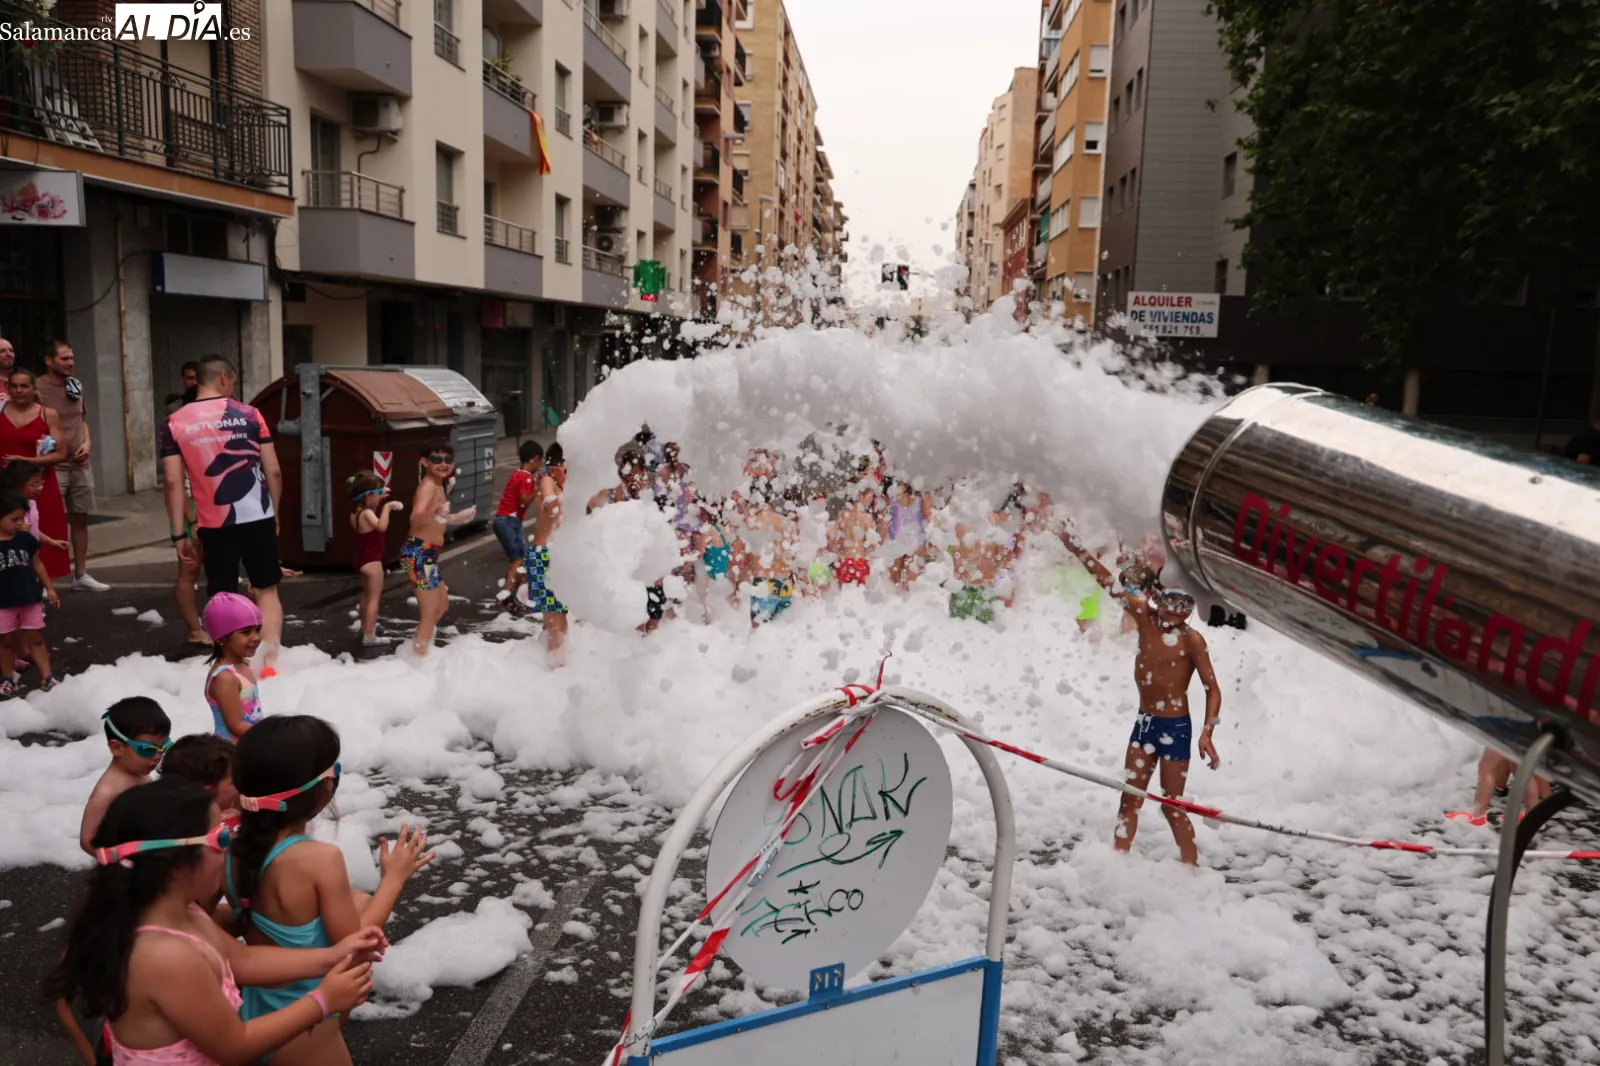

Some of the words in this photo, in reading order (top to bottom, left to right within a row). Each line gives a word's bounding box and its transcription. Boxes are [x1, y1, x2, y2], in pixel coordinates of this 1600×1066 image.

[1133, 295, 1193, 308] ALQUILER
[1130, 310, 1146, 323] DE
[1149, 310, 1214, 325] VIVIENDAS
[1161, 324, 1178, 334] 821
[185, 417, 248, 433] PETRONAS
